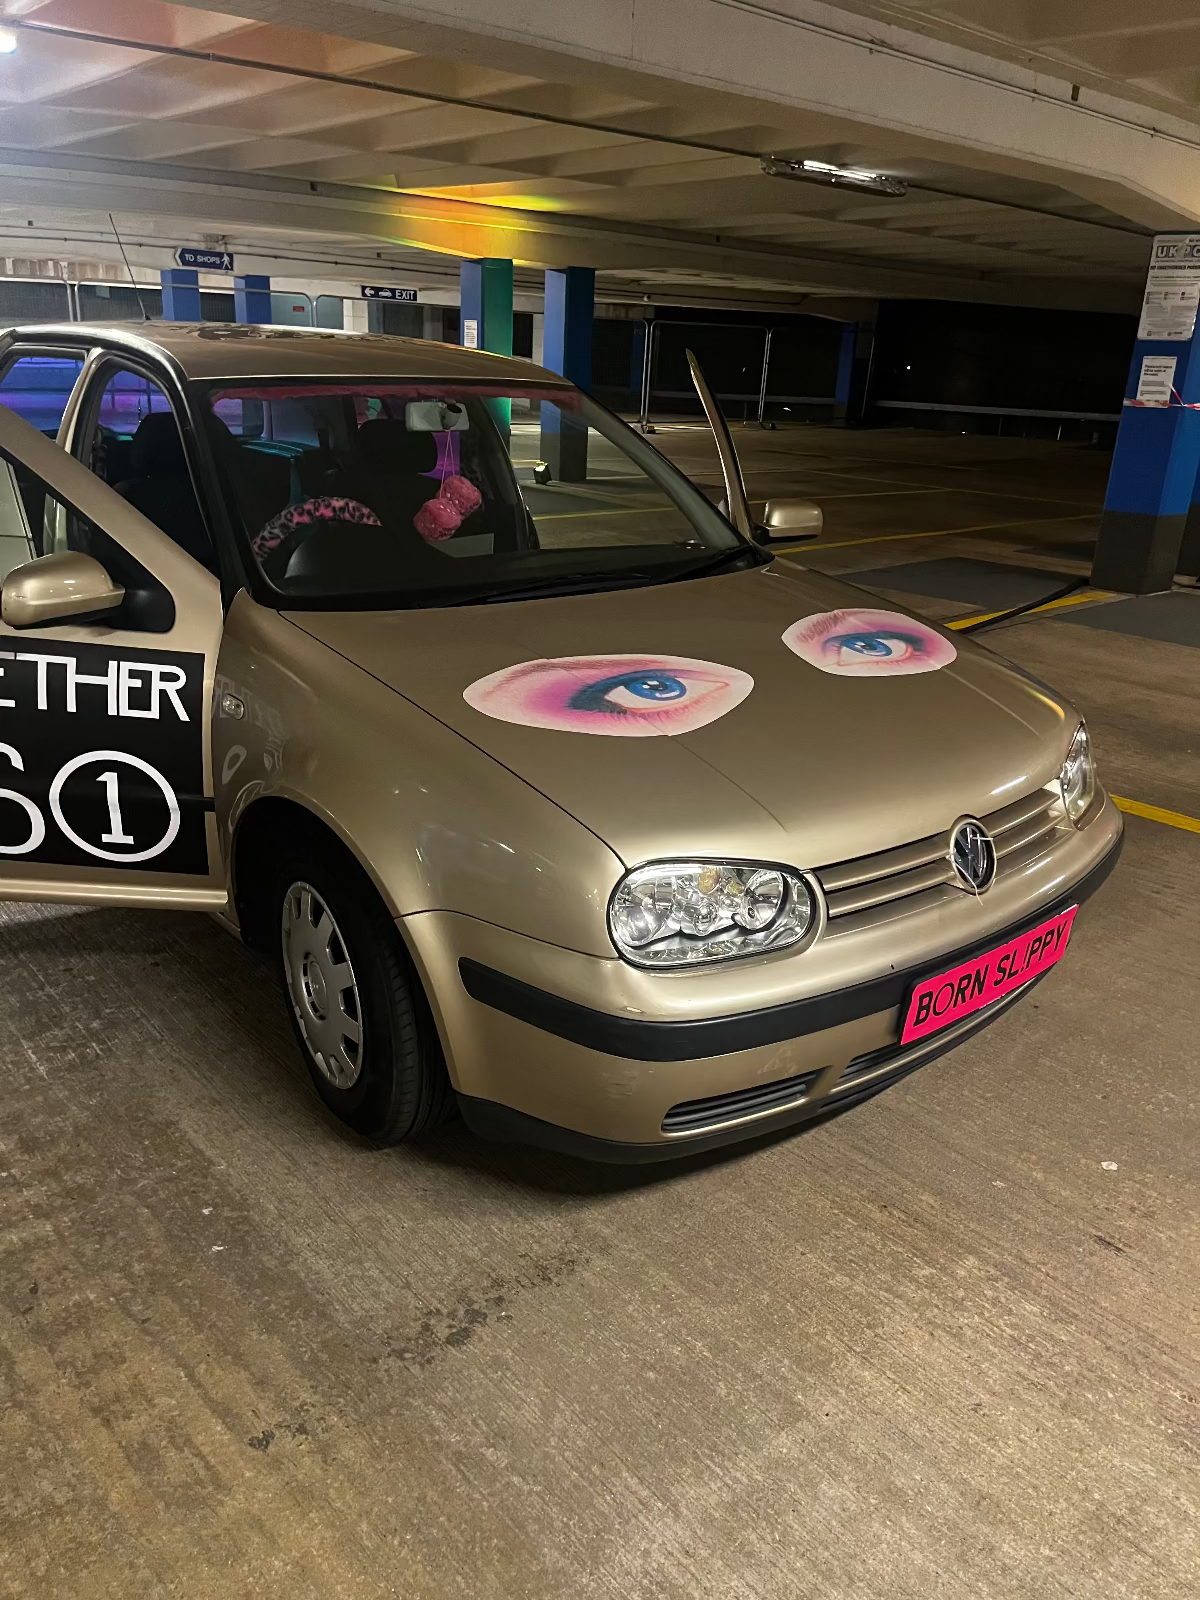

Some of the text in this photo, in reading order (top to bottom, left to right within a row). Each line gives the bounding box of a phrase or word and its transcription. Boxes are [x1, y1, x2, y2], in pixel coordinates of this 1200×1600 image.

[185, 253, 221, 264] TO SHOPS
[395, 289, 415, 300] EXIT
[913, 964, 990, 1028] BORN
